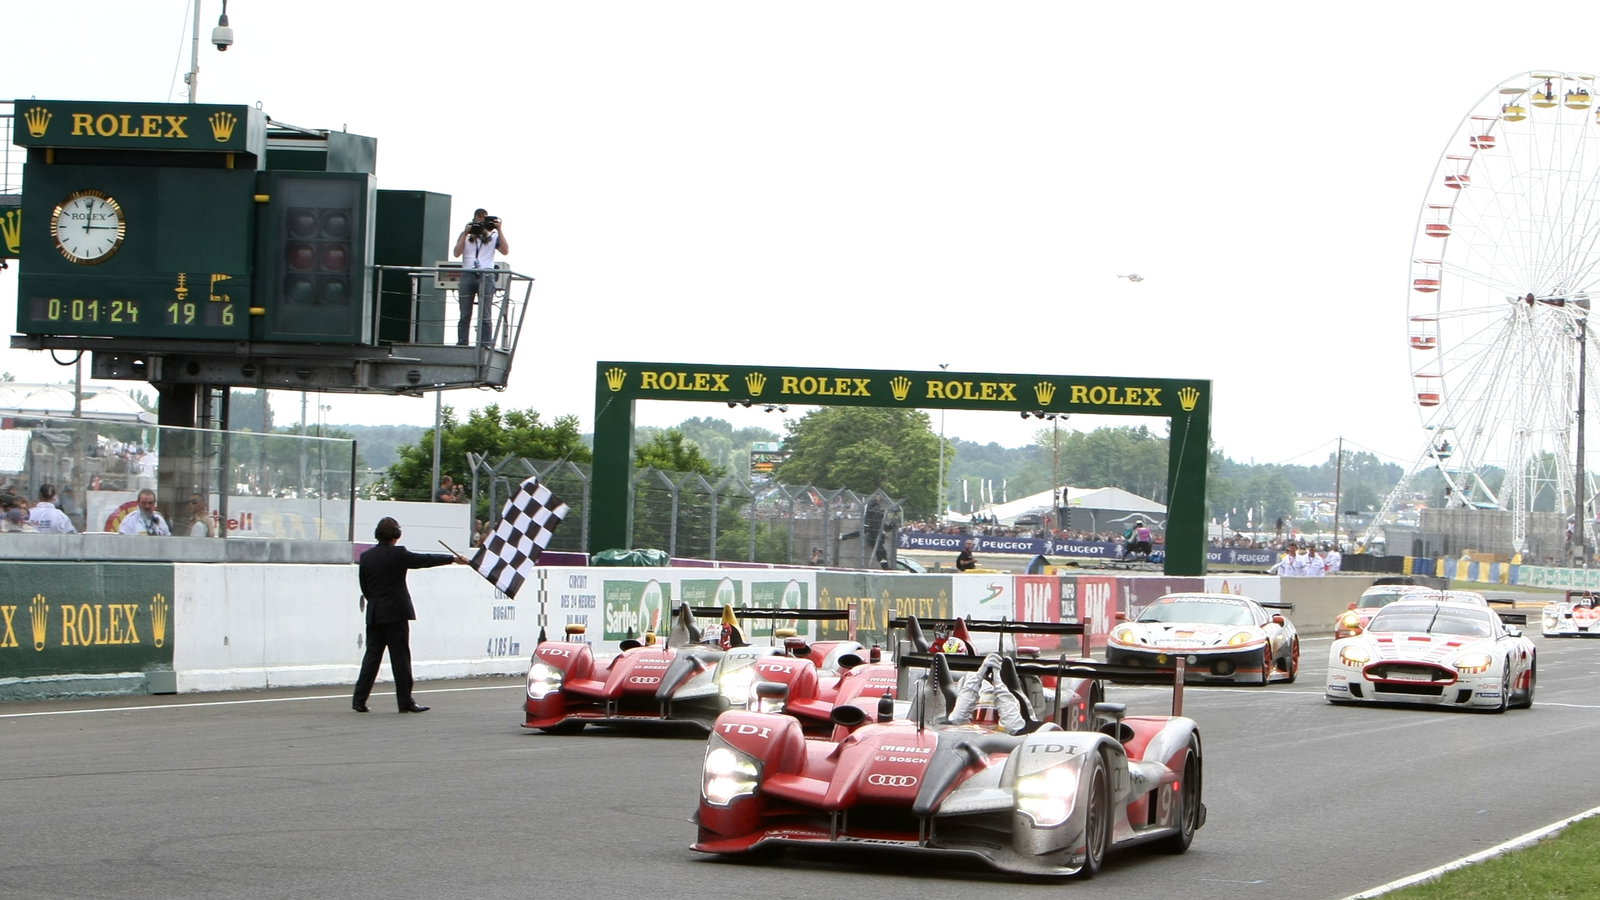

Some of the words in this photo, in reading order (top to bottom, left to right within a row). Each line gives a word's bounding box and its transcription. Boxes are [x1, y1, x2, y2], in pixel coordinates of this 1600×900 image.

[71, 113, 189, 138] ROLEX
[71, 212, 107, 221] ROLEX
[48, 299, 139, 326] 0:01:24
[168, 302, 196, 325] 19
[222, 303, 234, 326] 6
[640, 371, 730, 392] ROLEX
[780, 376, 871, 397] ROLEX
[926, 380, 1017, 401] ROLEX
[1070, 385, 1162, 406] ROLEX
[910, 537, 961, 547] PEUGEOT
[982, 540, 1033, 550] PEUGEOT
[1056, 544, 1105, 554] PEUGEOT
[1237, 553, 1270, 563] PEUGEOT
[569, 575, 588, 589] CIRCUIT
[560, 594, 570, 608] DES
[571, 594, 577, 608] 24
[578, 595, 596, 608] HEURES
[493, 606, 516, 620] BUGATTI
[606, 602, 638, 634] Sarthe
[61, 603, 140, 646] ROLEX
[487, 637, 508, 659] 4,185
[509, 636, 520, 656] km
[540, 648, 572, 657] TDI
[757, 664, 794, 674] TDI
[1071, 705, 1079, 732] 8
[721, 722, 774, 739] TDI
[880, 745, 931, 754] MAHLE
[1026, 743, 1079, 755] TDI
[888, 756, 928, 764] BOSCH
[1160, 783, 1172, 826] 9
